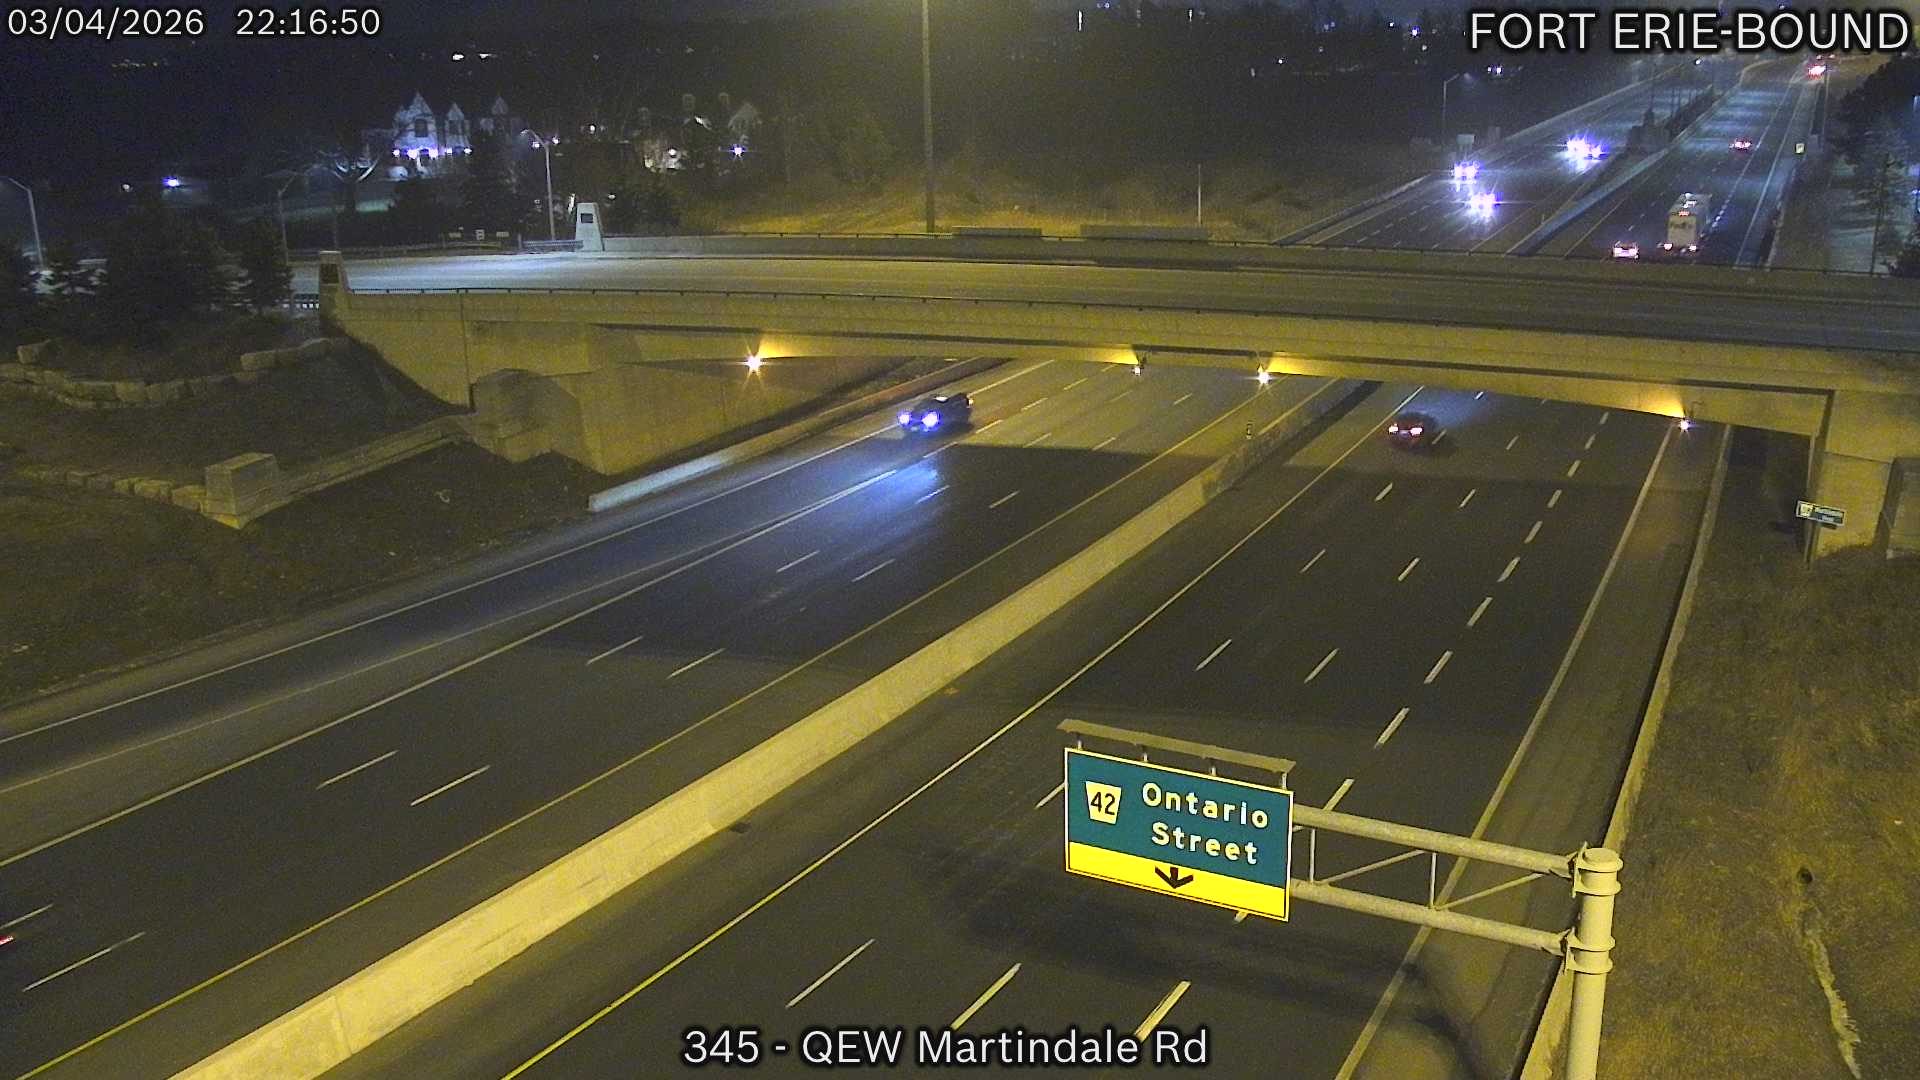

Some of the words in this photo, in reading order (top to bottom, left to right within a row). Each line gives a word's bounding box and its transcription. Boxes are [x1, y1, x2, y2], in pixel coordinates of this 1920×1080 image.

[1090, 791, 1116, 816] 42
[1142, 782, 1268, 829] Ontario
[1151, 821, 1258, 865] Street
